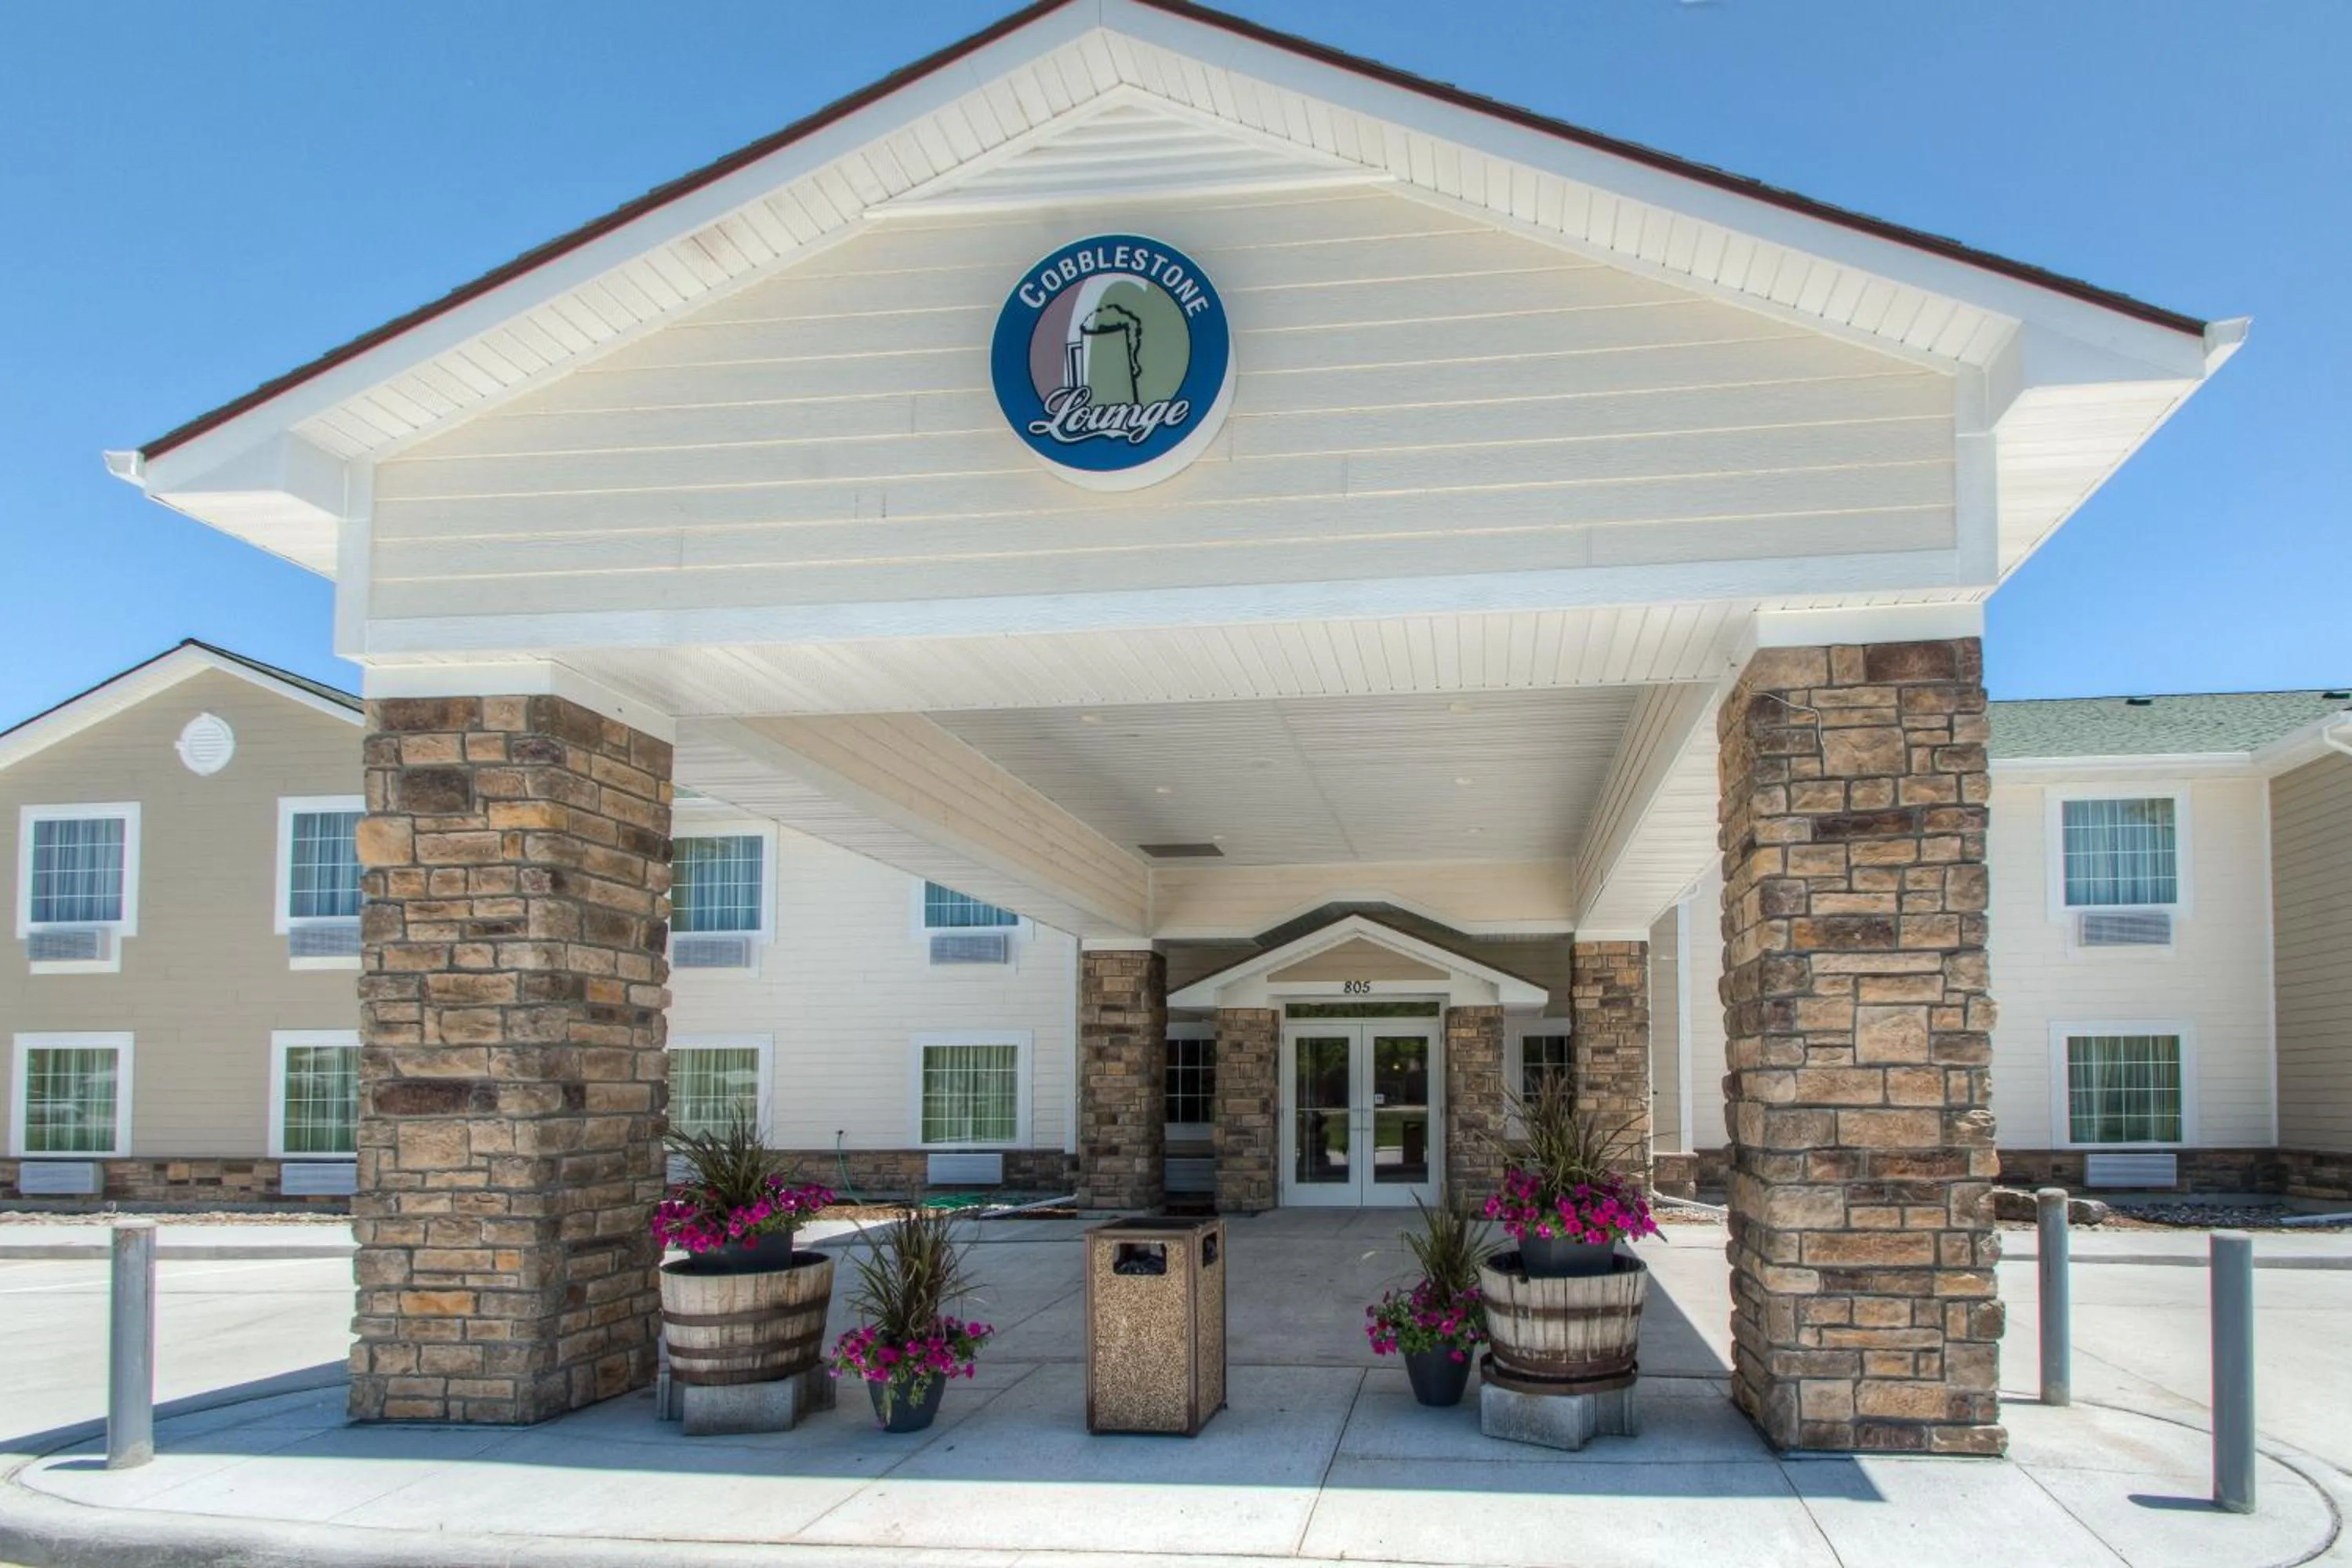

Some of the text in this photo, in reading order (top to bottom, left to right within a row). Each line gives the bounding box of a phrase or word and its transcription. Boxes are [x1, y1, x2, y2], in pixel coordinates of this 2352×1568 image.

[1018, 245, 1210, 318] COBBLESTONE
[1028, 387, 1190, 443] Lounge
[1344, 980, 1370, 993] 805
